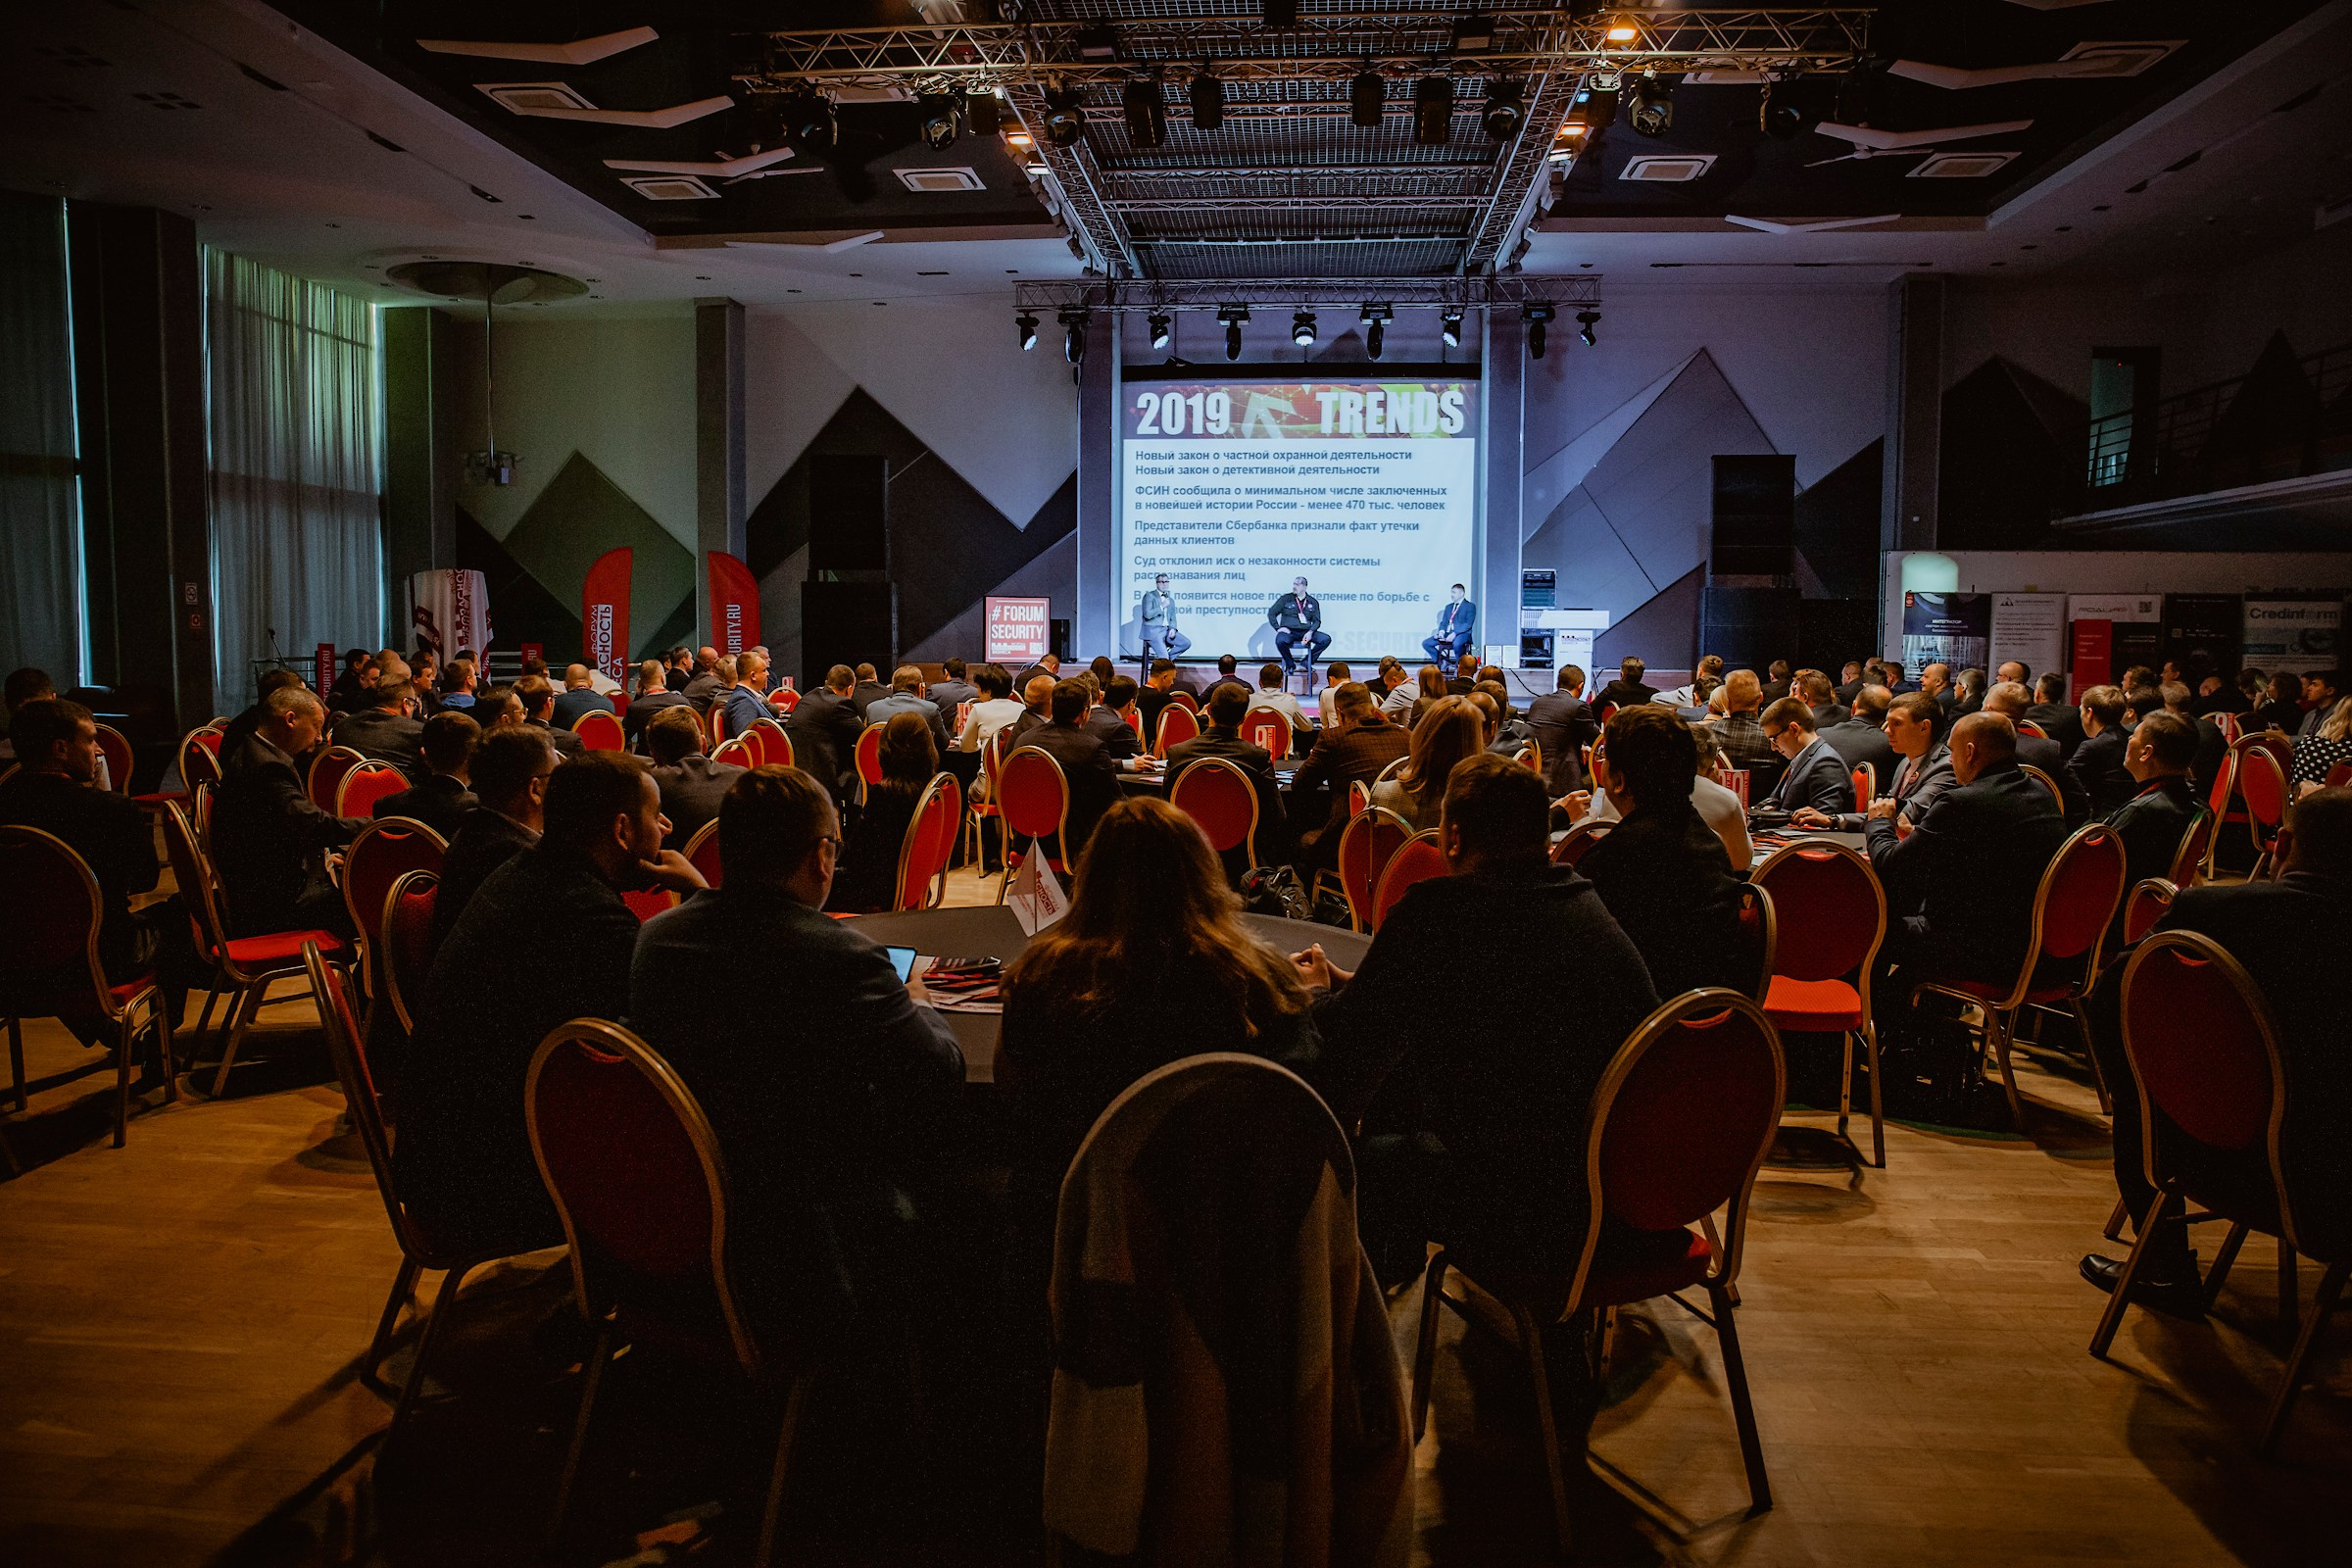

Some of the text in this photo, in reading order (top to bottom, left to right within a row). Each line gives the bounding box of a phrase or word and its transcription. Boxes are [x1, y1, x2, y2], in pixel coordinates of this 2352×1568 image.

[1136, 391, 1464, 436] 2019 TRENDS
[1136, 450, 1174, 460] Новый
[1224, 450, 1269, 460] частной
[1273, 450, 1328, 462] охранной
[1330, 451, 1412, 462] деятельности
[1135, 466, 1174, 474] Новый
[1222, 466, 1296, 476] детективной
[1298, 466, 1380, 476] деятельности
[1135, 485, 1170, 496] ФСИН
[1173, 485, 1231, 497] сообщила
[1367, 487, 1447, 496] заключенных
[1135, 501, 1142, 510] в
[1145, 500, 1202, 510] новейшей
[1206, 501, 1253, 512] истории
[1255, 500, 1298, 510] России
[1307, 501, 1343, 510] менее
[1346, 500, 1365, 510] 470
[1368, 501, 1395, 510] тыс.
[1397, 501, 1446, 510] человек
[1134, 520, 1420, 532] Представители Сбербанка признали факт утечки
[1134, 536, 1235, 545] данных клиентов
[1134, 556, 1156, 567] Суд
[1158, 557, 1213, 565] отклонил
[1248, 557, 1327, 565] незаконности
[1330, 557, 1381, 566] системы
[1134, 571, 1246, 582] распзнавания лиц
[1134, 591, 1142, 600] В
[1230, 592, 1265, 601] новое
[1359, 592, 1373, 601] по
[1377, 591, 1420, 604] борьбе
[1423, 593, 1430, 602] с
[1004, 606, 1044, 621] FORUM
[1196, 607, 1269, 616] преступност
[726, 604, 742, 657] URITY.RU
[992, 624, 1044, 640] SECURITY
[598, 606, 611, 677] АСНОСТЬ
